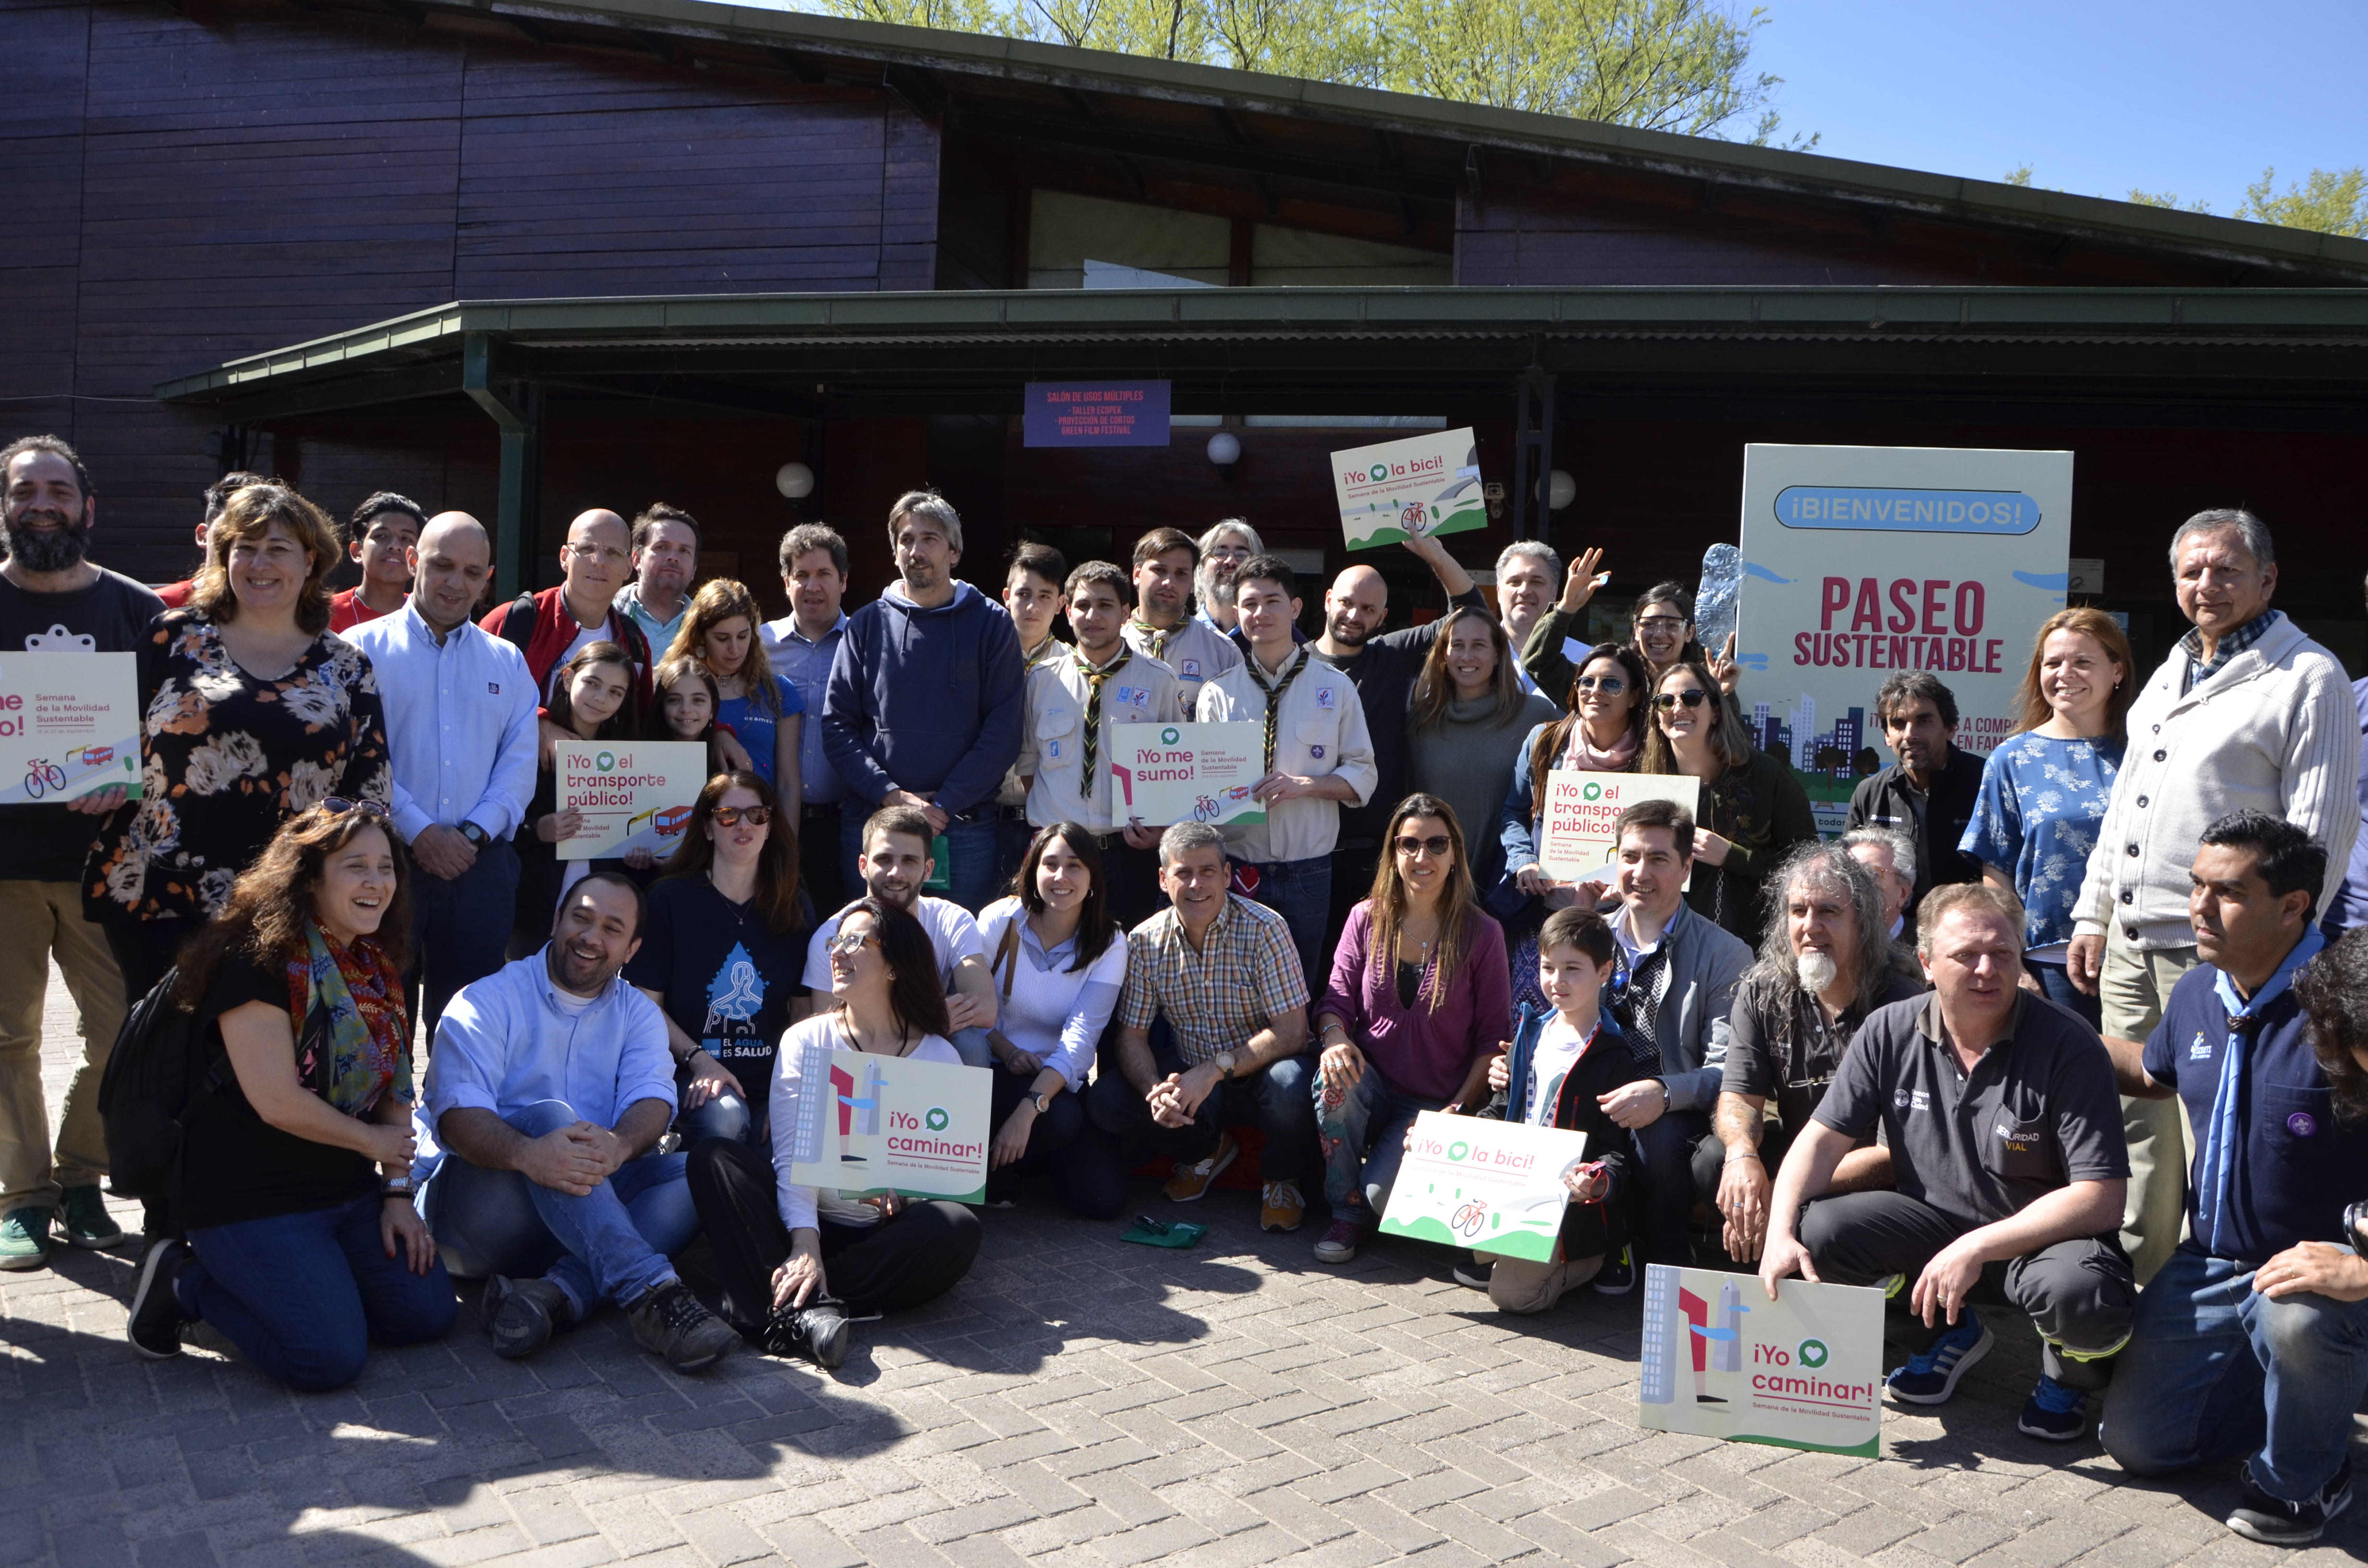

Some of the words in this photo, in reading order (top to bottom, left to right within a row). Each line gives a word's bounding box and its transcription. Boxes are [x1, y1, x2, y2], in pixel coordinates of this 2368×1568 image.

[1047, 390, 1071, 402] SALÓN
[1073, 392, 1082, 401] DE
[1084, 392, 1102, 401] USOS
[1104, 390, 1144, 401] MÚLTIPLES
[1097, 406, 1122, 414] ECOPEK
[1110, 416, 1135, 424] CORTOS
[1061, 427, 1083, 435] GREEN
[1084, 426, 1099, 434] FILM
[1101, 426, 1131, 434] FESTIVAL
[1391, 463, 1406, 476] la
[1410, 455, 1443, 473] bici!
[1386, 483, 1412, 492] Movilidad
[1413, 477, 1446, 488] Sustentable
[1792, 497, 2022, 525] ¡BIENVENIDOS!
[1821, 576, 1986, 637] PASEO
[1793, 632, 2004, 673] SUSTENTABLE
[63, 704, 110, 712] Movilidad
[1963, 717, 1972, 732] A
[1957, 735, 1973, 750] EN
[567, 754, 591, 769] ¡Yo
[619, 754, 633, 769] el
[1137, 749, 1161, 764] ¡Yo
[1166, 750, 1194, 762] me
[1137, 765, 1194, 782] sumo!
[567, 773, 666, 791] transporte
[567, 790, 633, 808] público!
[1556, 784, 1578, 797] ¡Yo
[1605, 785, 1619, 799] el
[1552, 818, 1616, 834] público!
[723, 1049, 732, 1057] ES
[734, 1045, 772, 1057] SALUD
[735, 1039, 764, 1047] AGUA
[890, 1111, 919, 1130] ¡Yo
[1996, 1124, 2039, 1141] SEGURIDAD
[888, 1137, 983, 1159] caminar!
[2006, 1140, 2027, 1151] VIAL
[1418, 1139, 1443, 1155] ¡Yo
[1471, 1146, 1489, 1162] la
[1494, 1150, 1535, 1169] bici!
[1455, 1171, 1486, 1181] Movilidad
[1488, 1176, 1526, 1188] Sustentable
[1754, 1344, 1790, 1366] ¡Yo
[1752, 1374, 1873, 1403] caminar!
[1752, 1402, 1779, 1411] Semana
[1799, 1408, 1830, 1417] Movilidad
[1832, 1411, 1871, 1422] Sustentable
